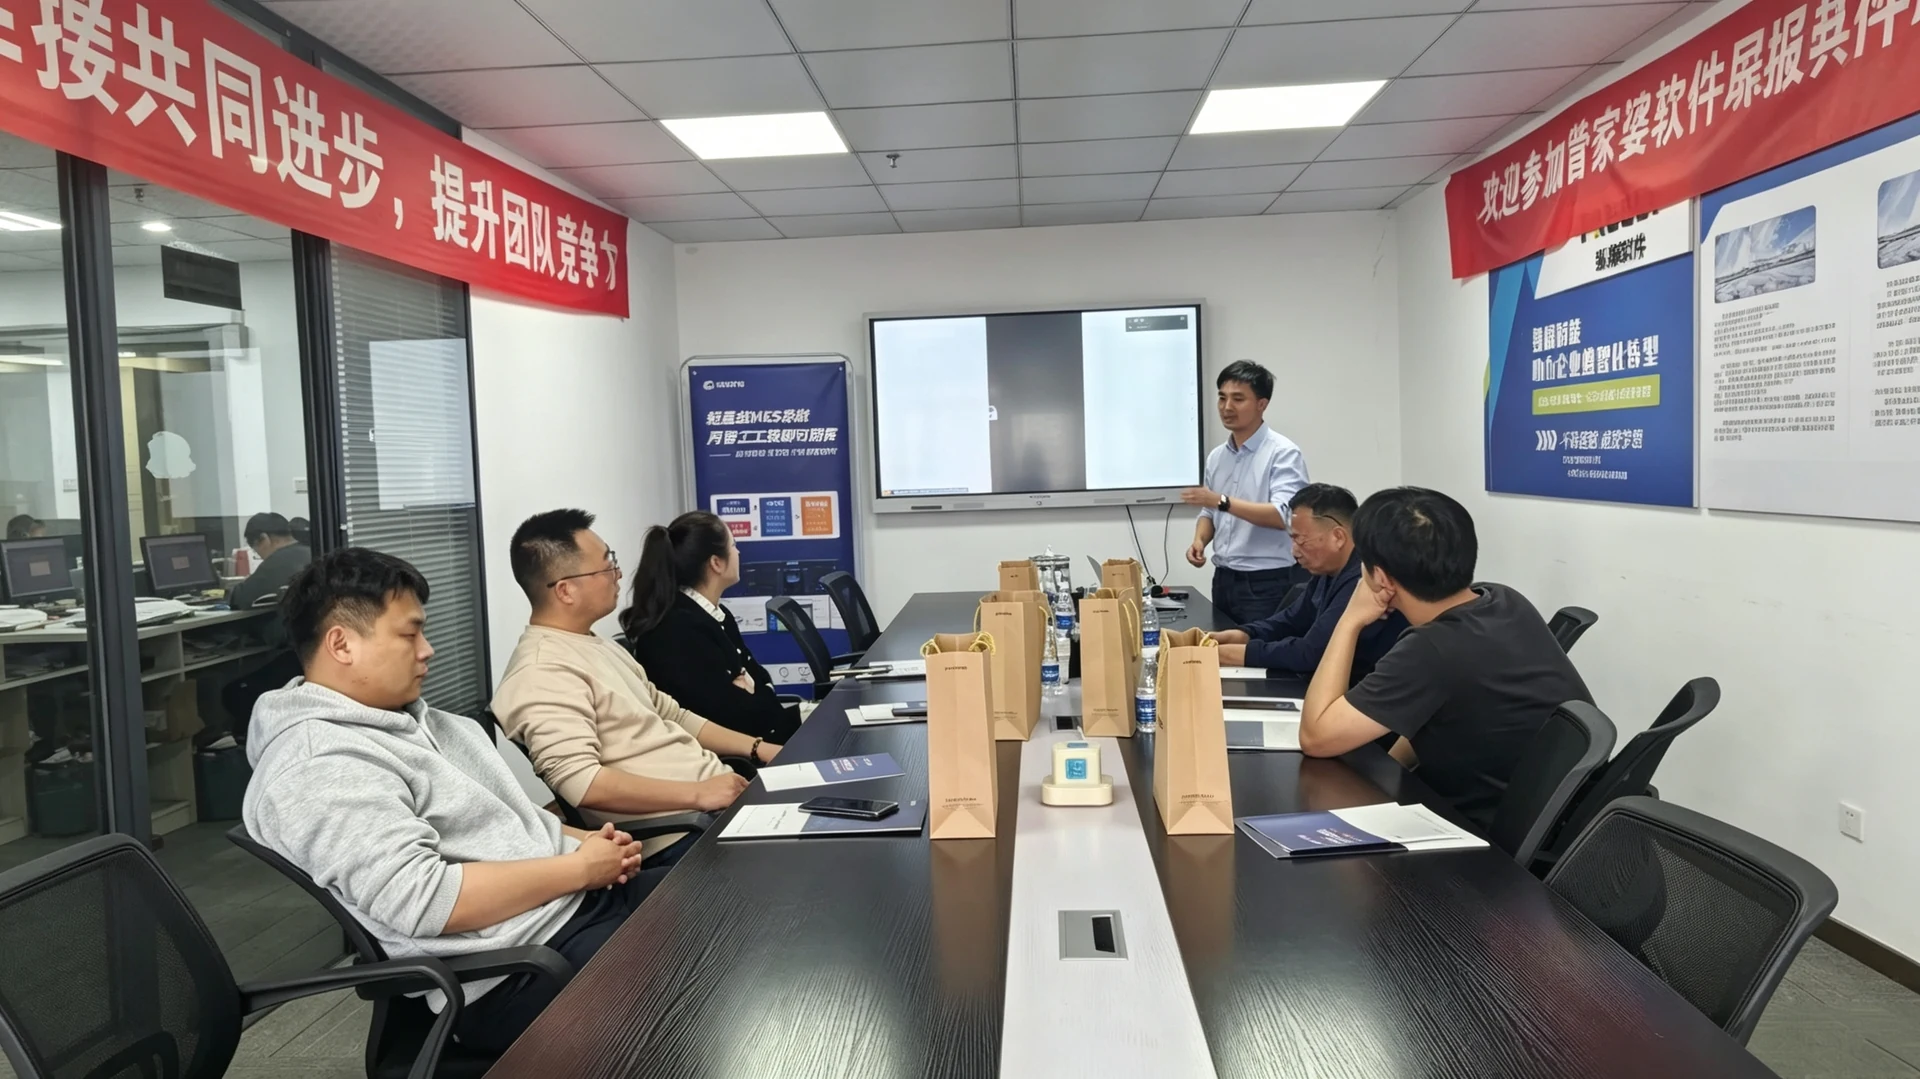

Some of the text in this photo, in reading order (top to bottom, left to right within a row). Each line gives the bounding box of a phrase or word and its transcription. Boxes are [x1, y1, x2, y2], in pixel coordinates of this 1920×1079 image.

[0, 0, 618, 291] 接共同进步，提升团队竞争力
